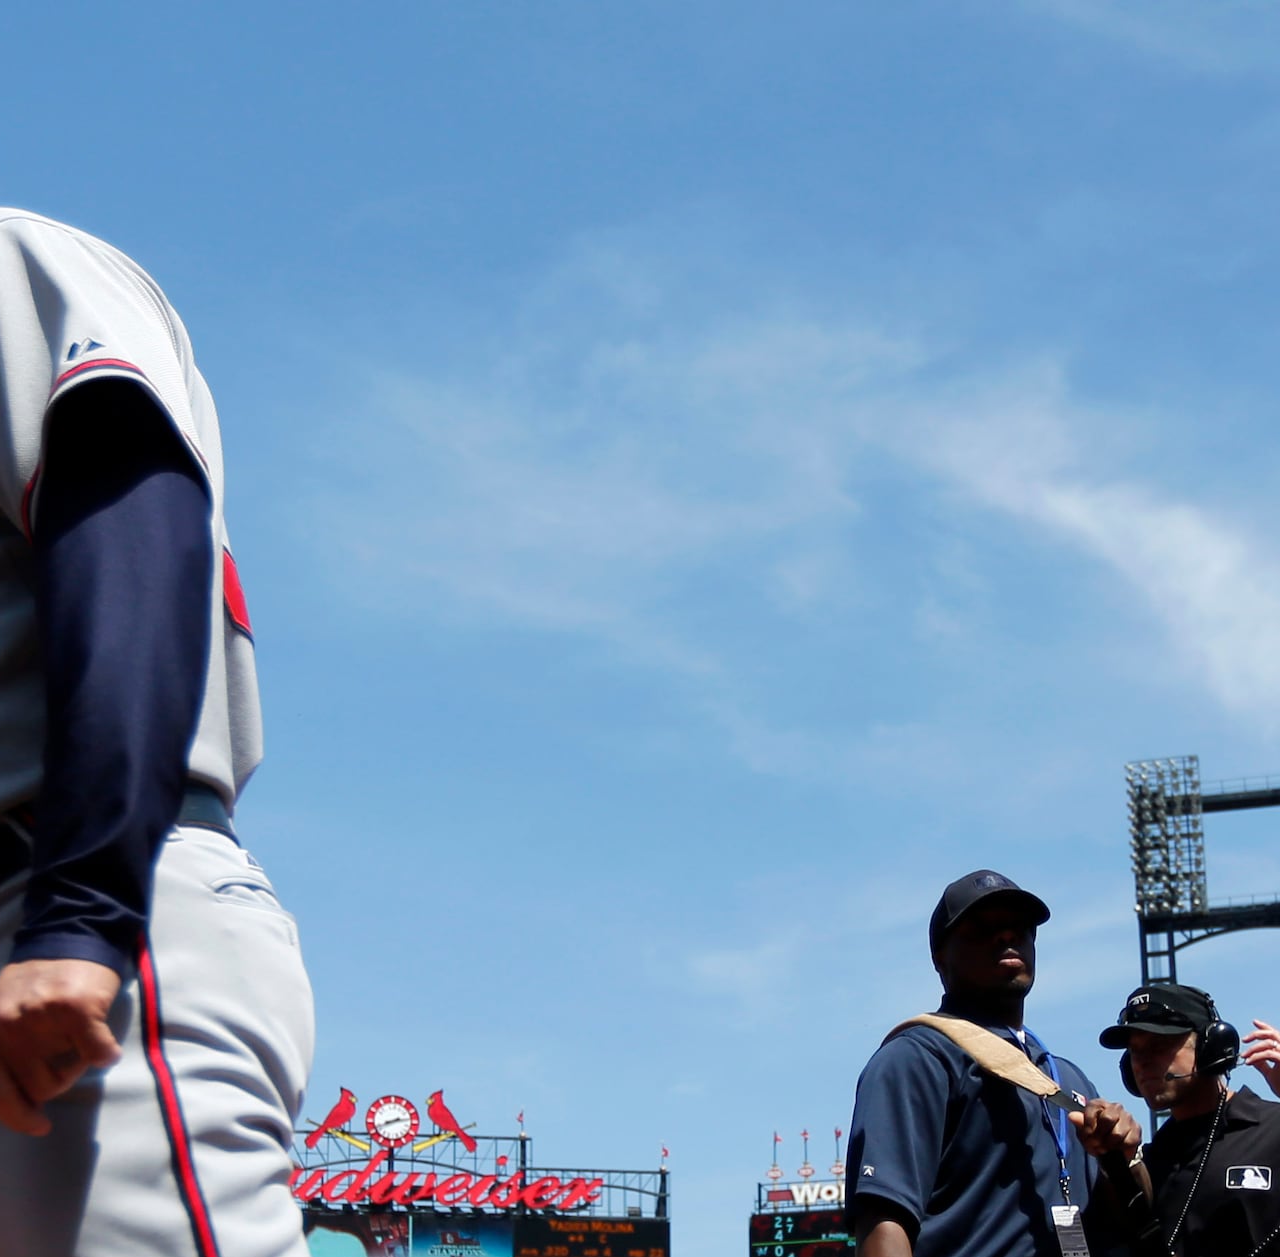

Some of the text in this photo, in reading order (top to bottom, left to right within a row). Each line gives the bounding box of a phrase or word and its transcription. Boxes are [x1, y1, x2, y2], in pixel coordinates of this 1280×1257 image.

[775, 1216, 783, 1228] 2
[774, 1230, 783, 1241] 4
[775, 1245, 783, 1257] 0
